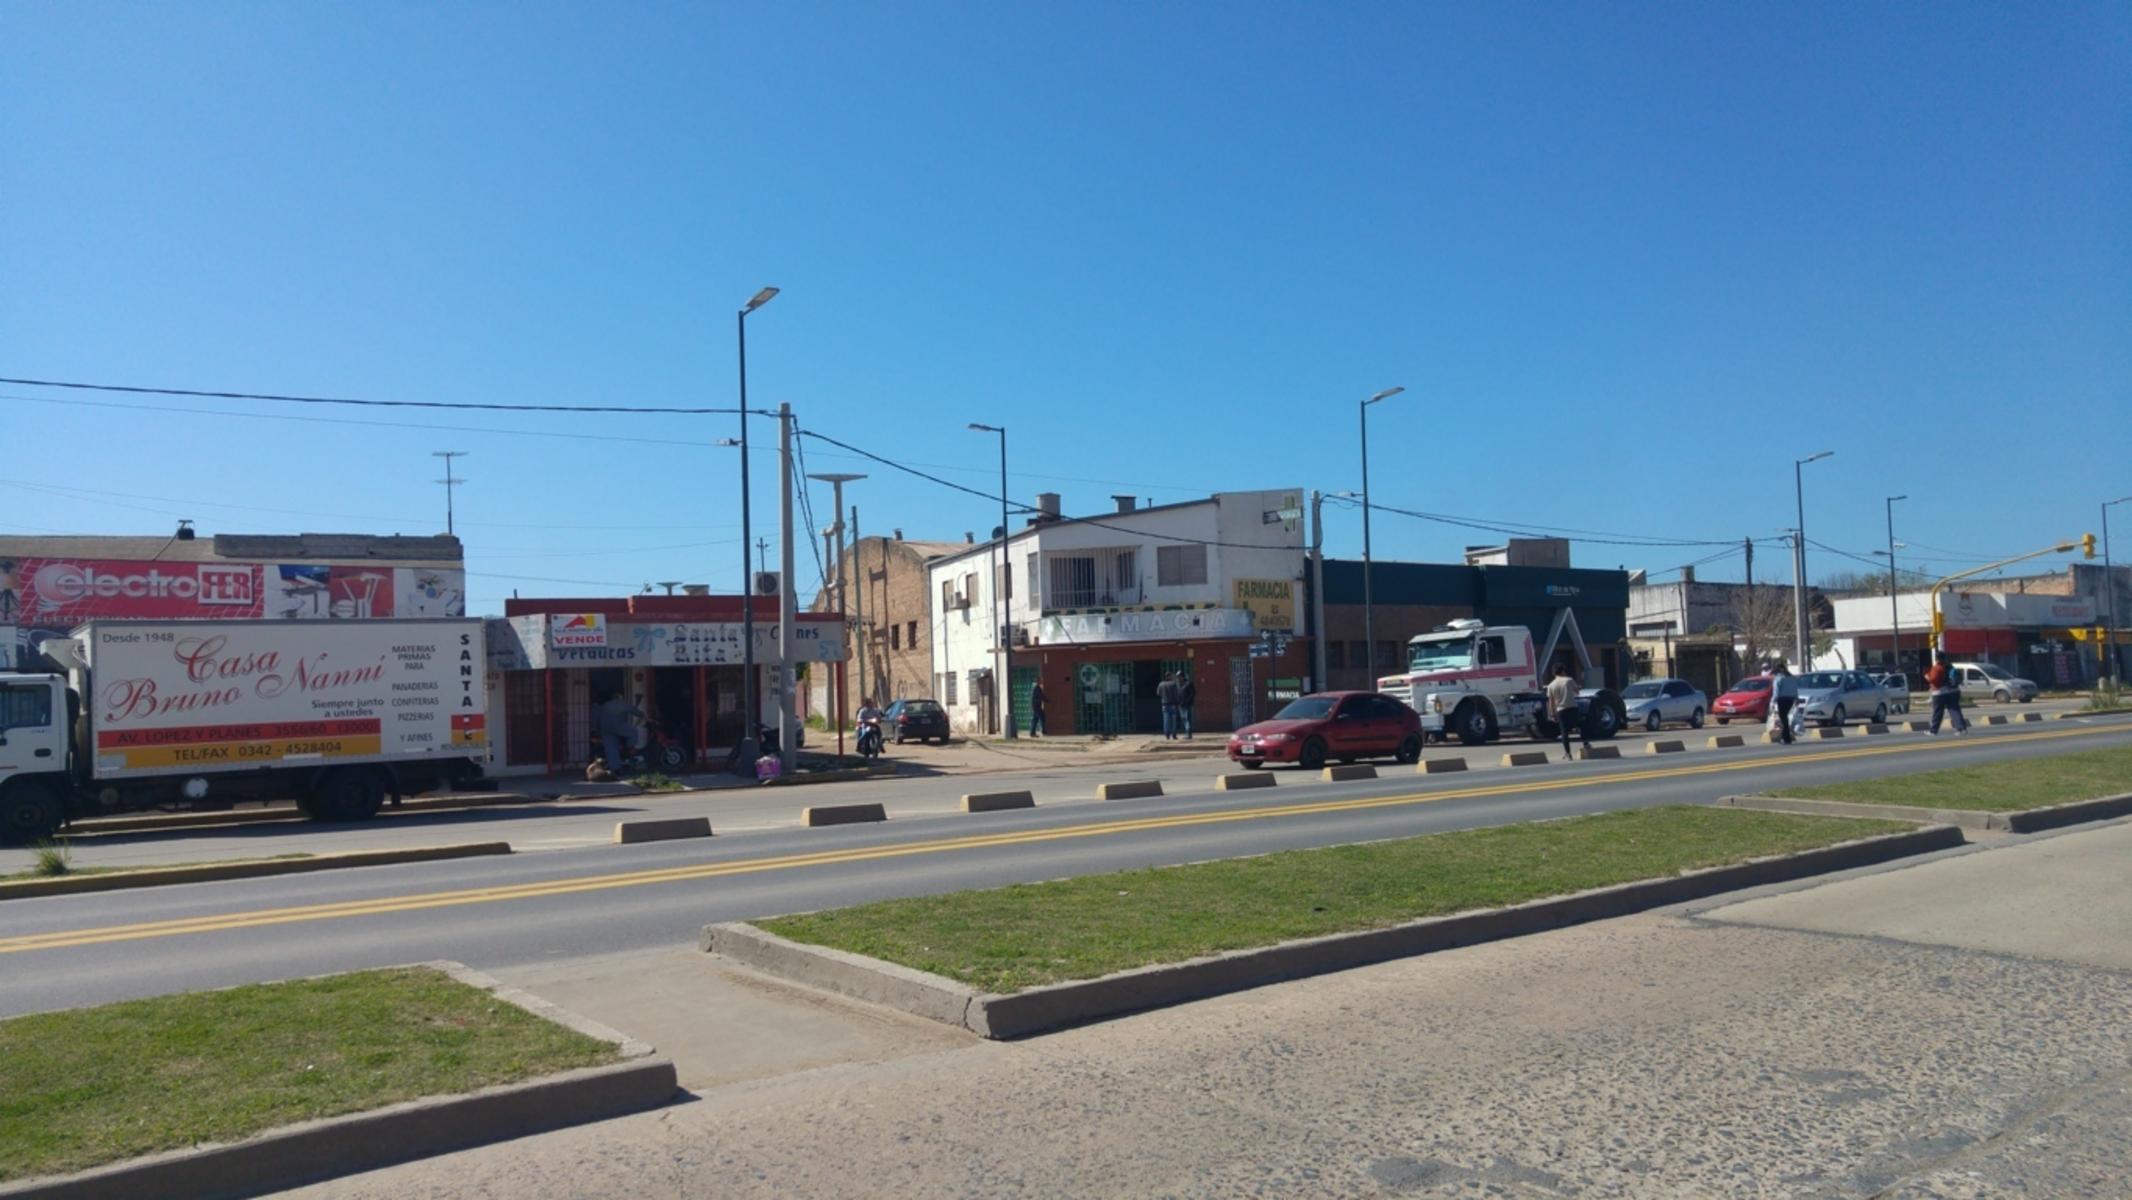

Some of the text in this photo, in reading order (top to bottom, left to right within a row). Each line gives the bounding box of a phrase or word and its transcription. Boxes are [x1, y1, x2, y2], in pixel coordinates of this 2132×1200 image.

[1238, 581, 1290, 599] FARMACIA
[1061, 609, 1226, 634] FARMACIA
[102, 632, 175, 643] Desde 1948
[769, 625, 819, 641] Cnes
[555, 635, 604, 645] VENDE
[392, 645, 437, 654] MATERIAS
[174, 634, 280, 683] Casa
[398, 653, 432, 661] PRIMAS
[404, 662, 425, 671] PARA
[460, 633, 472, 707] SANTA
[103, 652, 386, 723] Bruno Nanni
[392, 682, 439, 691] PANADERIAS
[311, 698, 385, 710] Siempre junto
[391, 697, 440, 706] CONFITERIAS
[324, 708, 374, 718] a ustedes
[398, 712, 435, 721] PIZZERIAS
[145, 730, 192, 743] LOPEZ
[196, 729, 205, 739] Y
[208, 727, 261, 740] PLANES
[400, 733, 433, 742] Y AFINES
[174, 747, 229, 760] TEL/FAX
[238, 745, 272, 757] 0342
[286, 742, 342, 754] 4528404
